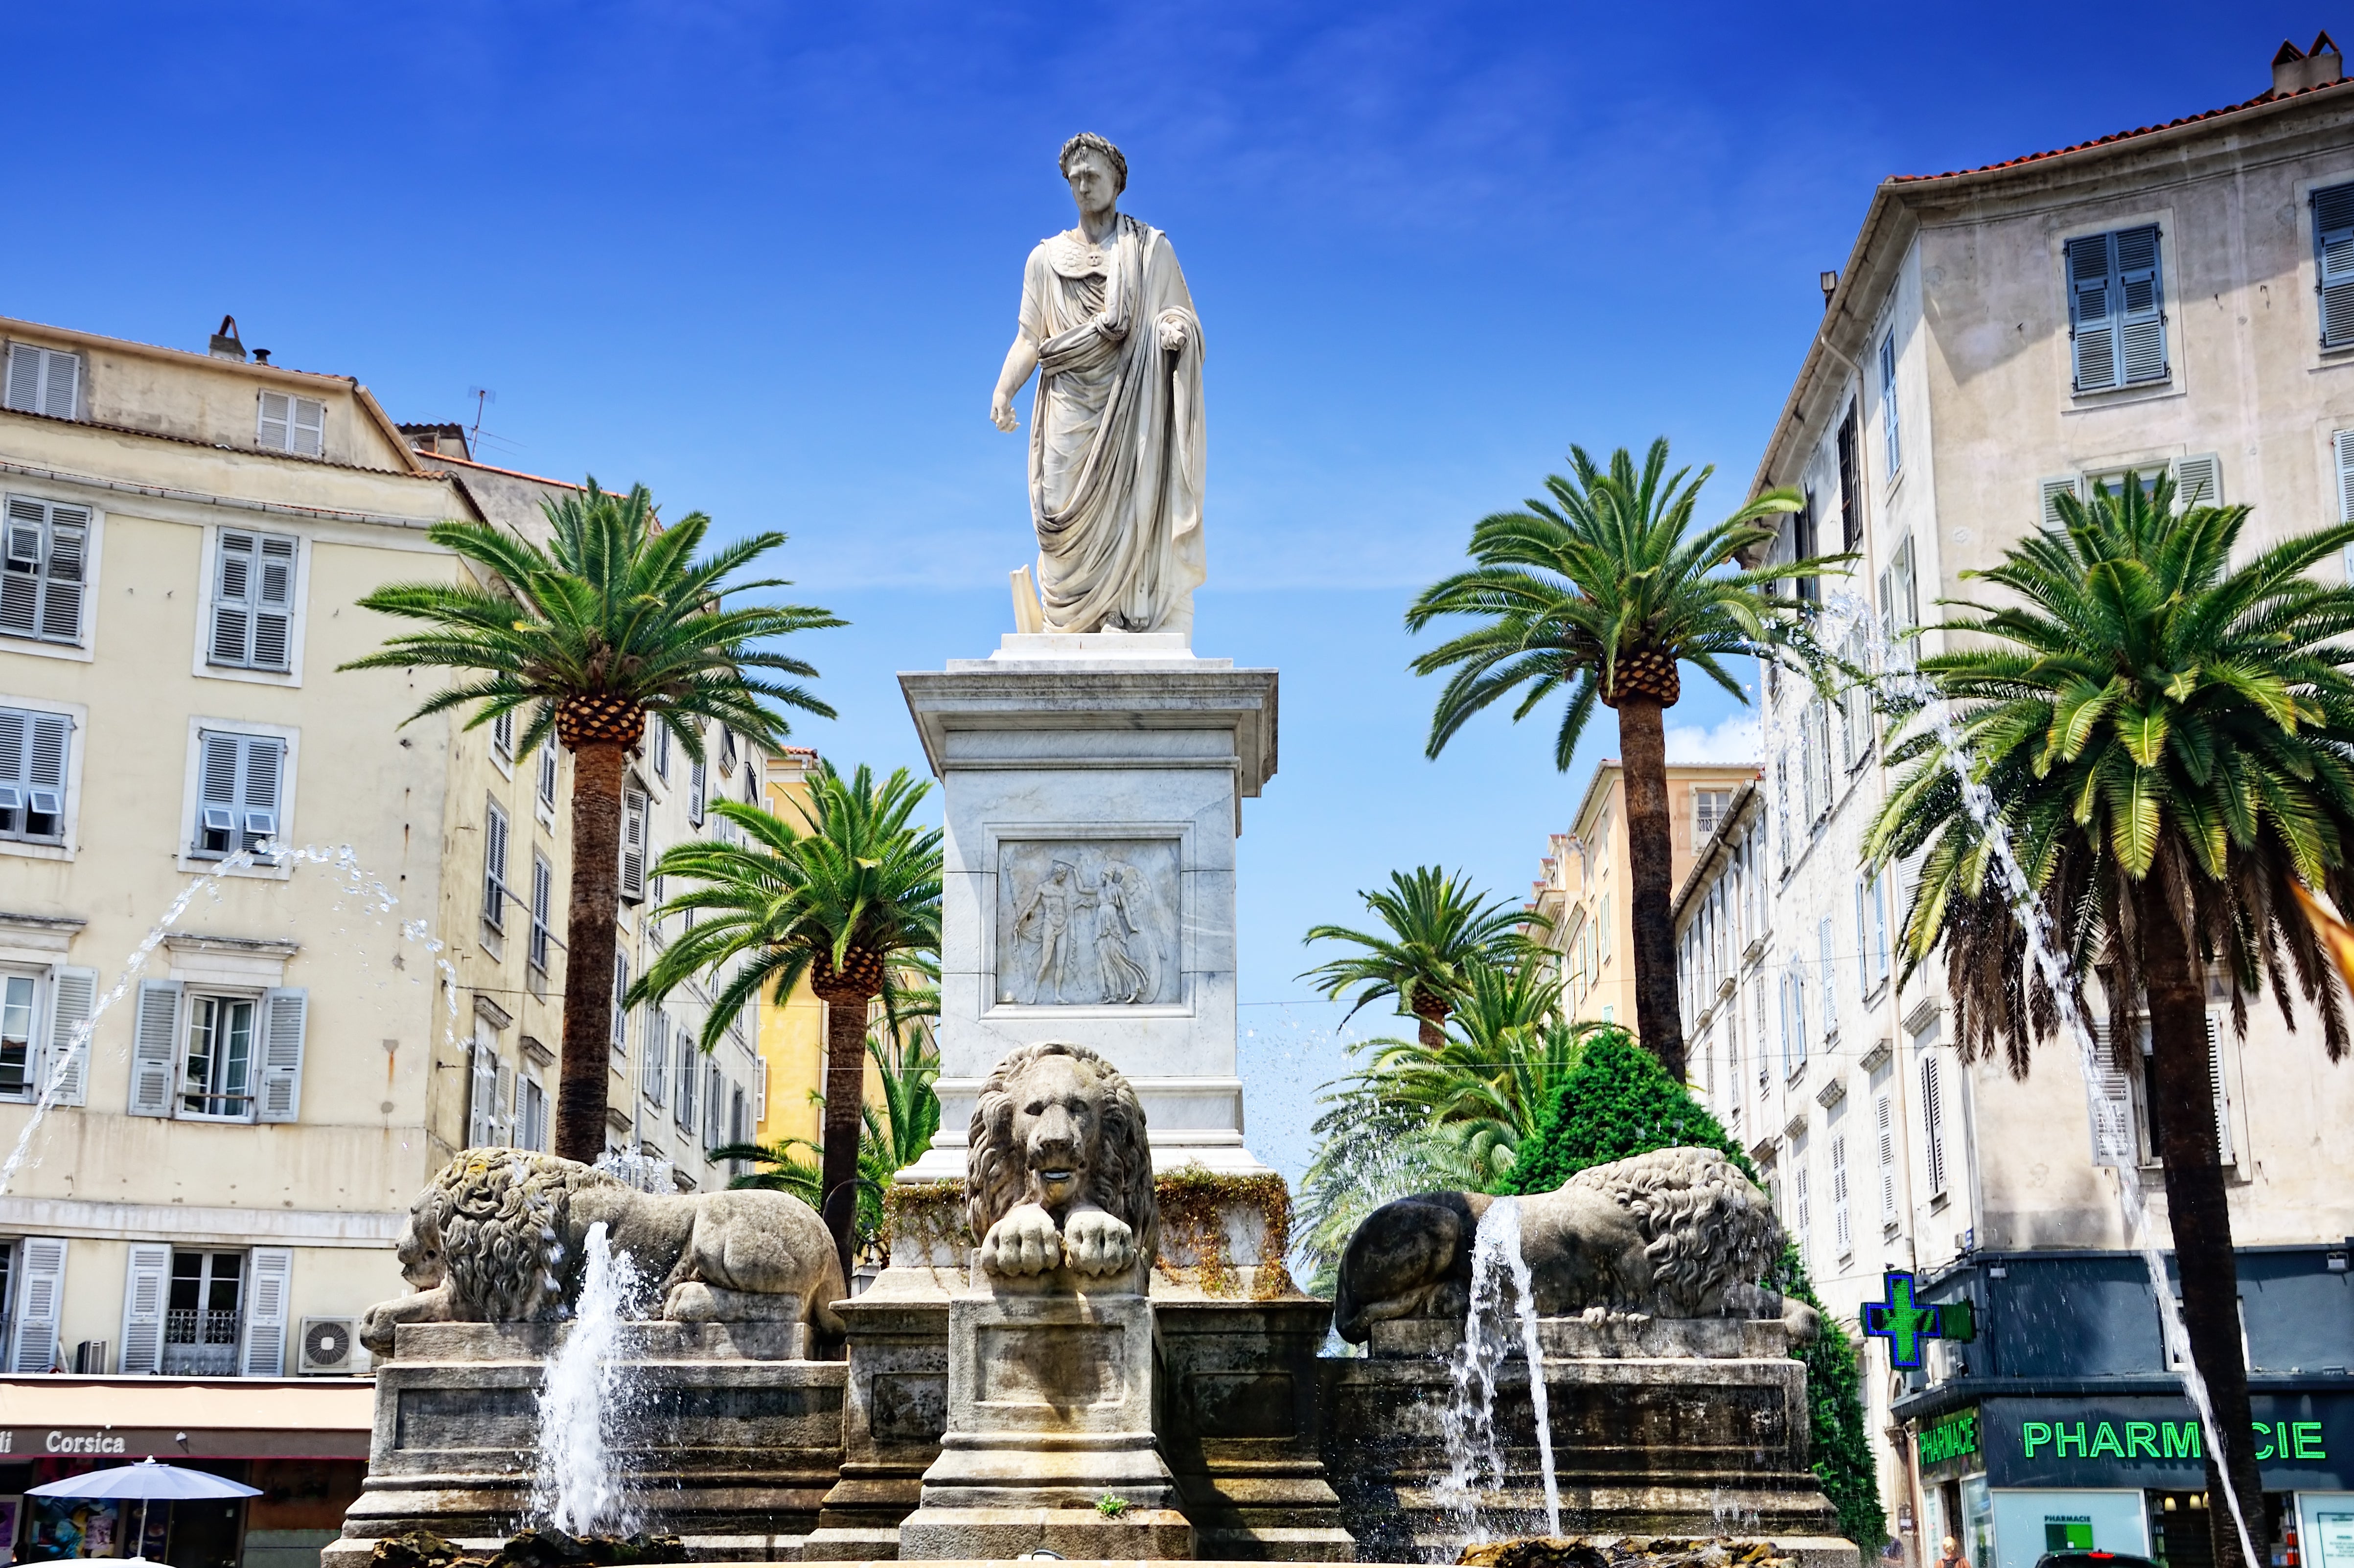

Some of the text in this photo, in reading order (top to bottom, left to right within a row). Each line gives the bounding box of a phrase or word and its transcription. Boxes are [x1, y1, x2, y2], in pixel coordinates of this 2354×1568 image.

[46, 1430, 125, 1453] Corsica
[1919, 1417, 1975, 1465] PHARMACIE
[2023, 1422, 2326, 1459] PHARMCIE
